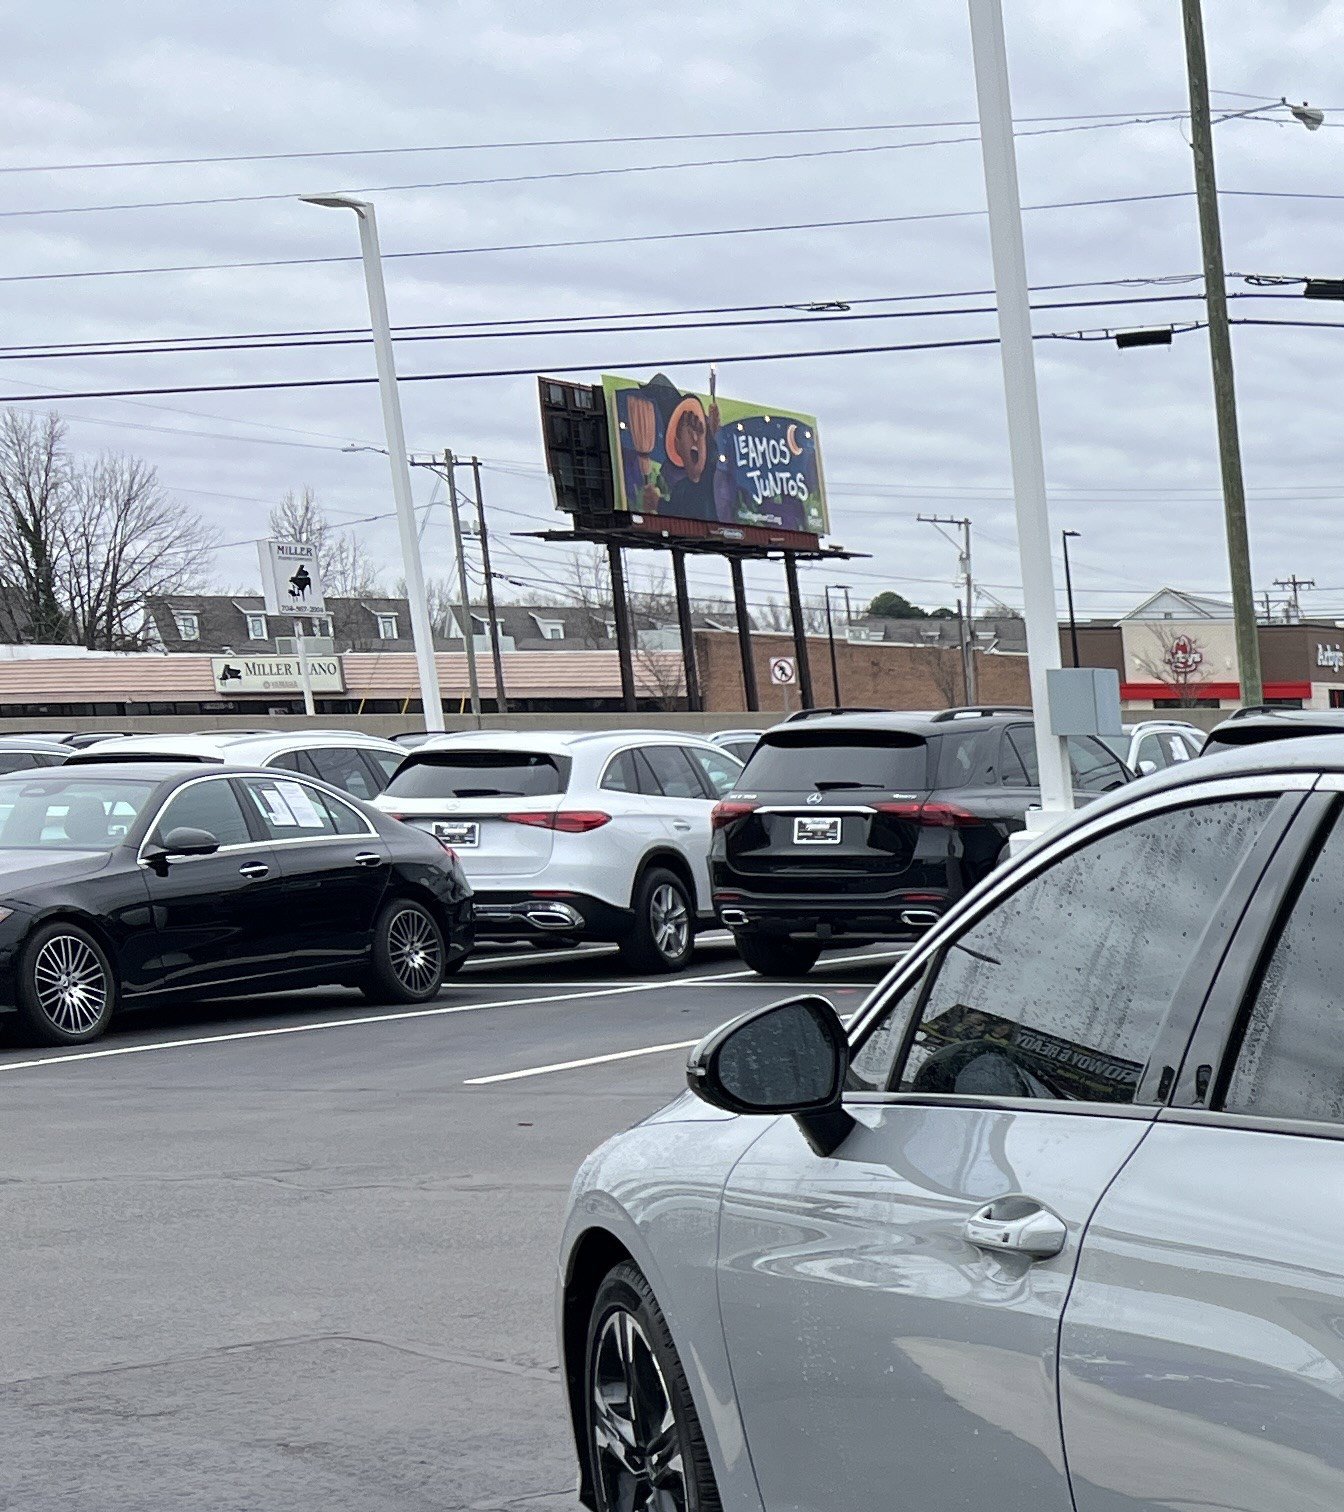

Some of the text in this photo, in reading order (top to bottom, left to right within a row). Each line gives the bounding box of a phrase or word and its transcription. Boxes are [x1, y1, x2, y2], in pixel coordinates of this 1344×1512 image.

[733, 434, 791, 469] LEAMOS
[277, 545, 313, 556] MILLER
[244, 662, 337, 676] MILLER ANO
